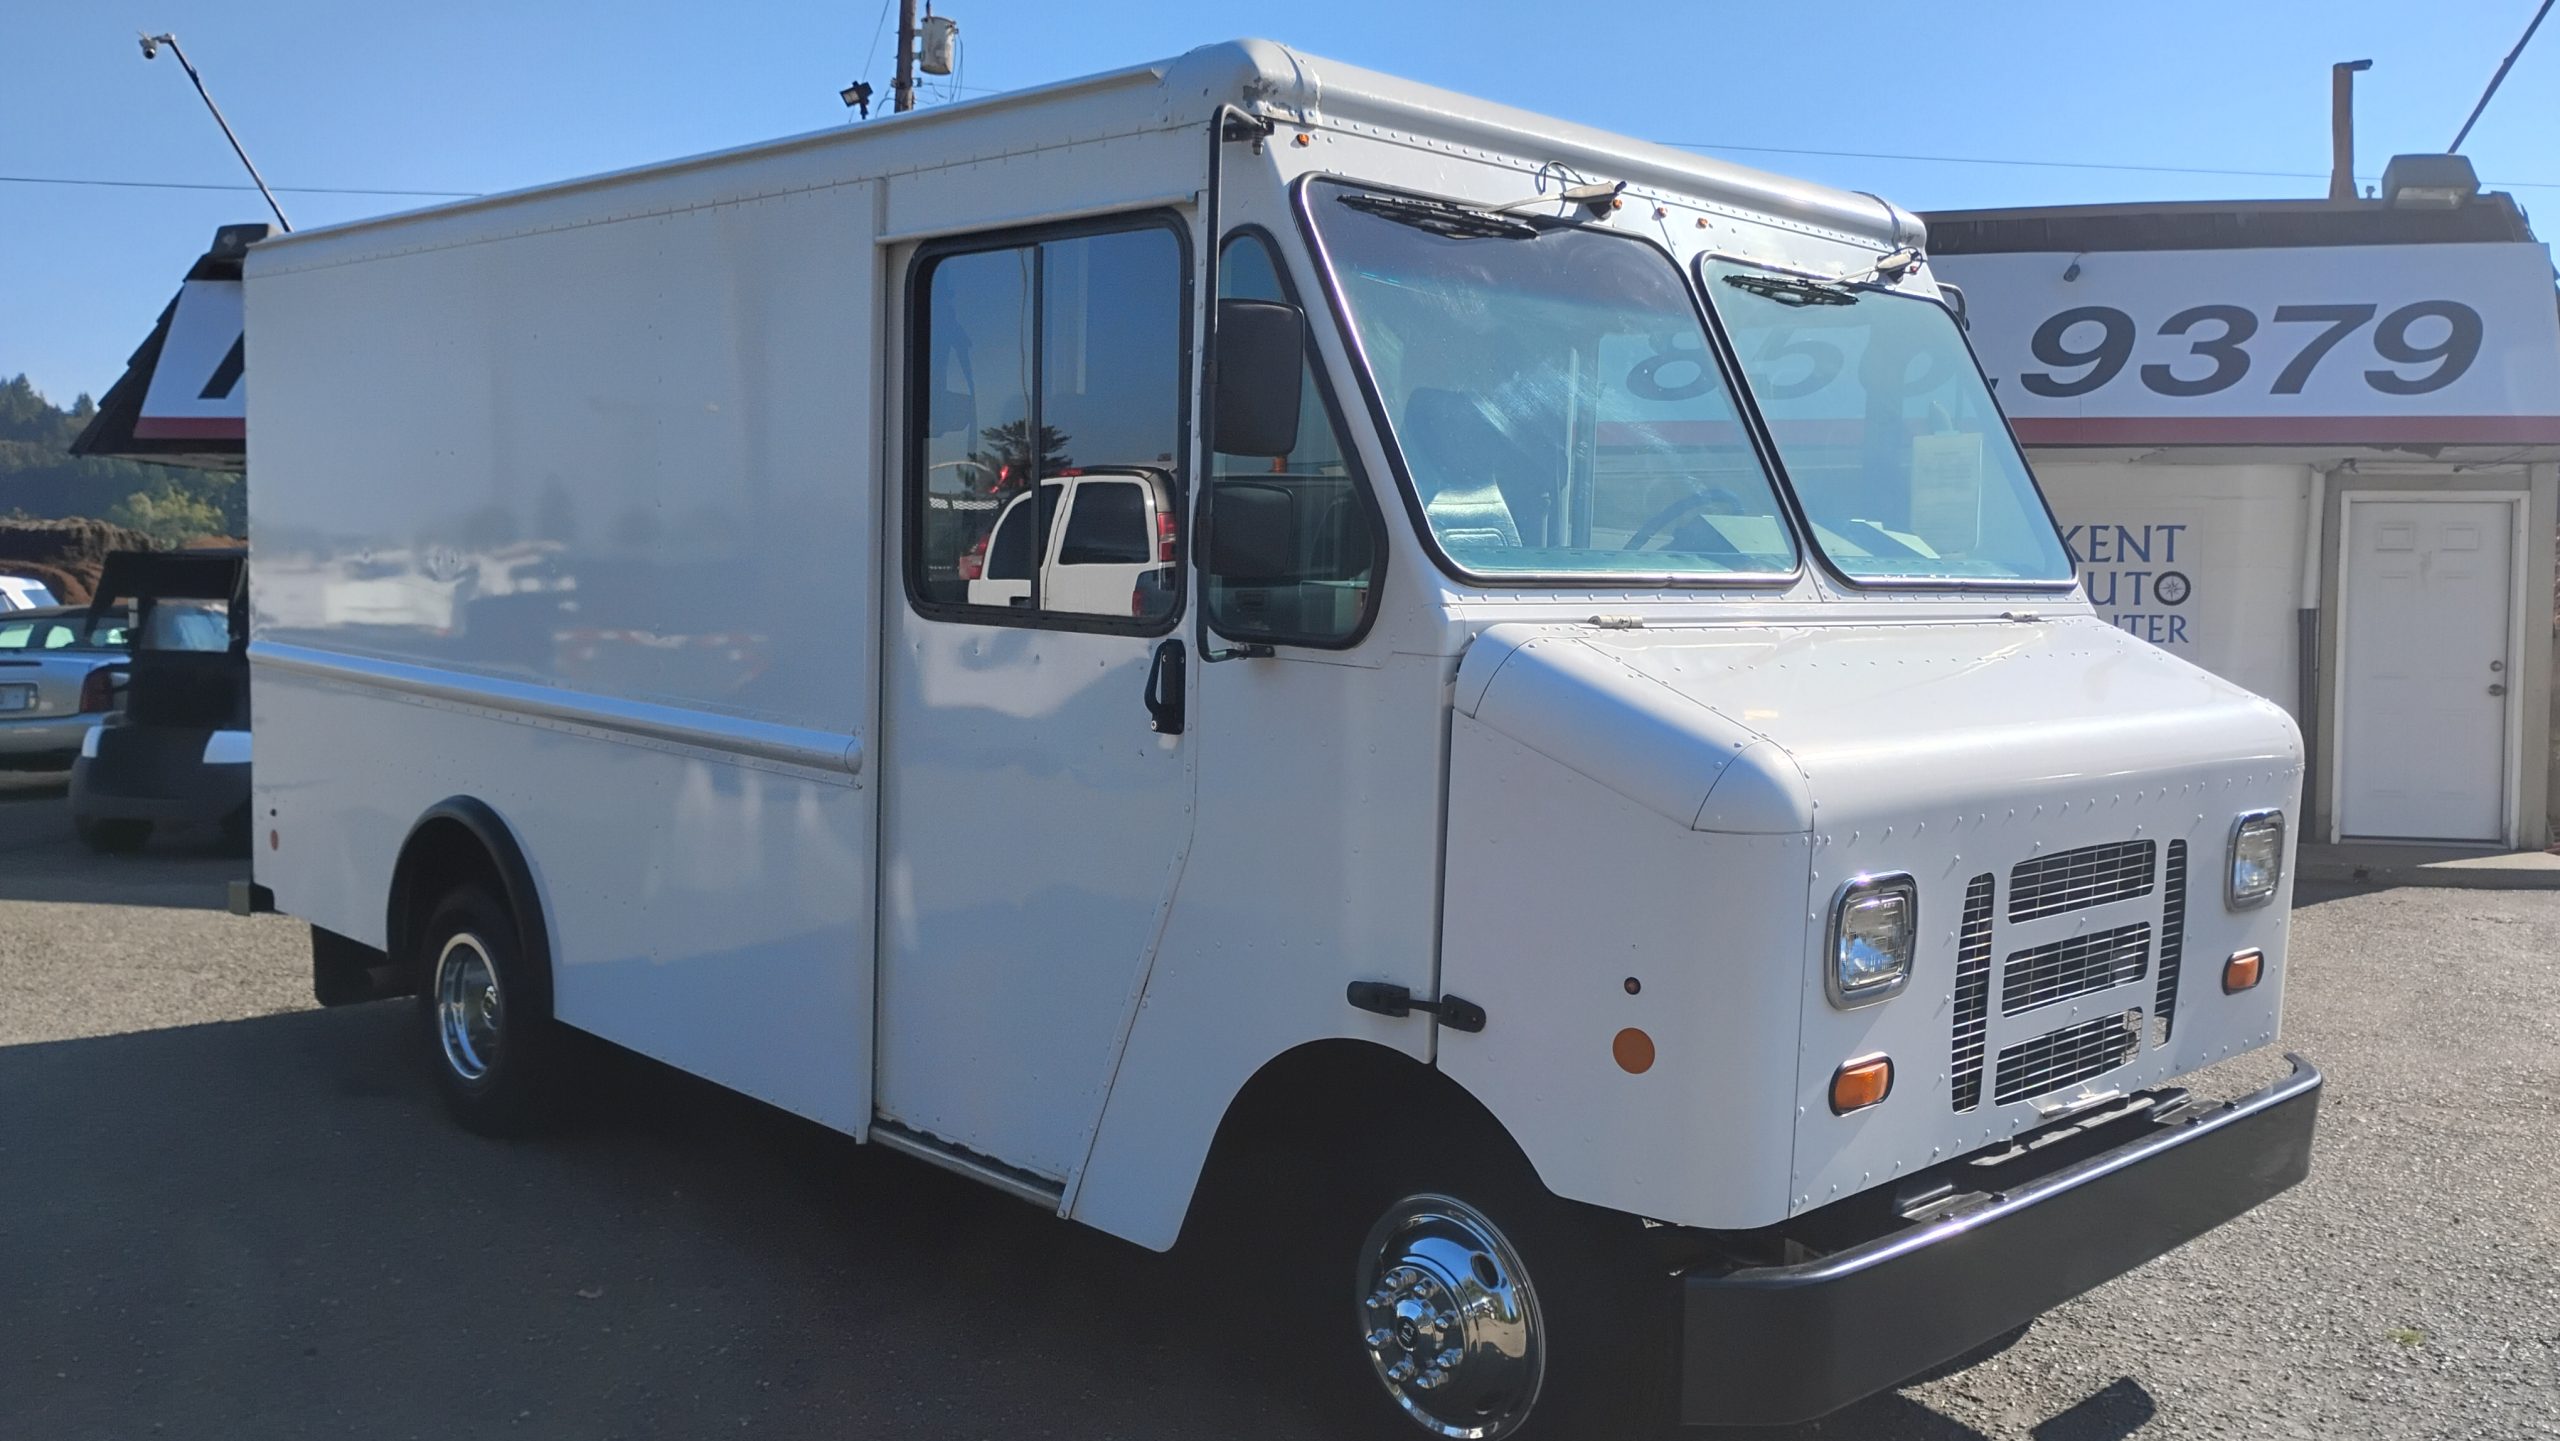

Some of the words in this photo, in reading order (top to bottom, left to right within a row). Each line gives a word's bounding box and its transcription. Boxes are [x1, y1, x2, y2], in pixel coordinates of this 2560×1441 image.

[2059, 524, 2187, 563] KENT
[2086, 570, 2192, 607] UTO
[2113, 614, 2189, 643] TER
